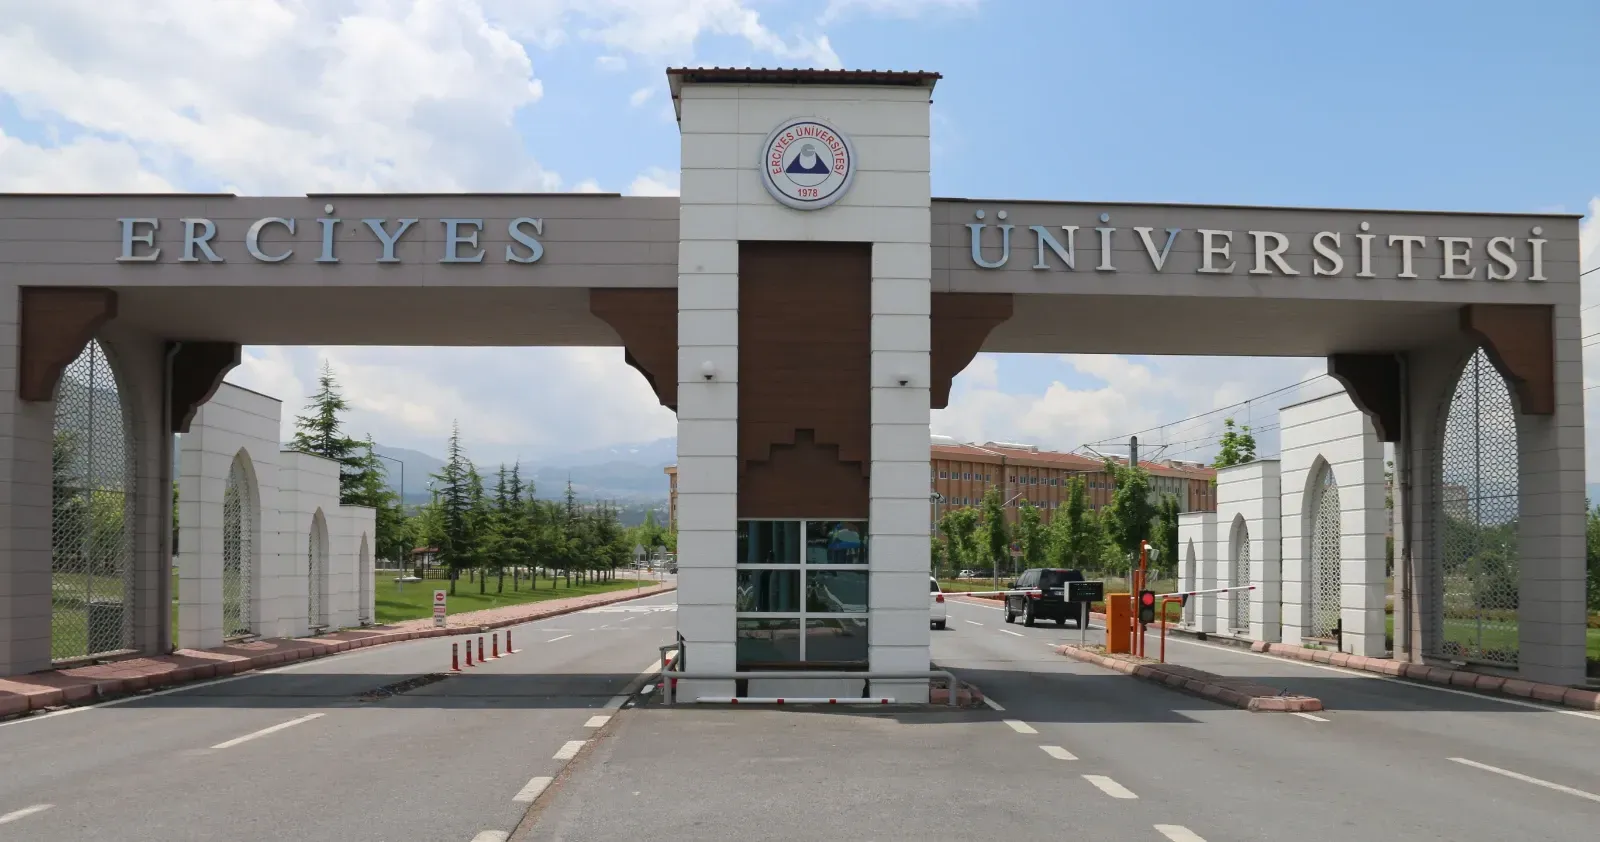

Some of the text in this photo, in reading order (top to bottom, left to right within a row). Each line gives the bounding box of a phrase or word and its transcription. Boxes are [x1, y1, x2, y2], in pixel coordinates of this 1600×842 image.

[771, 125, 845, 177] ERCİYES ÜNİVERSİTESİ
[797, 188, 818, 198] 1978
[115, 203, 1549, 283] ERCİYES ÜNİVERSİTESİ
